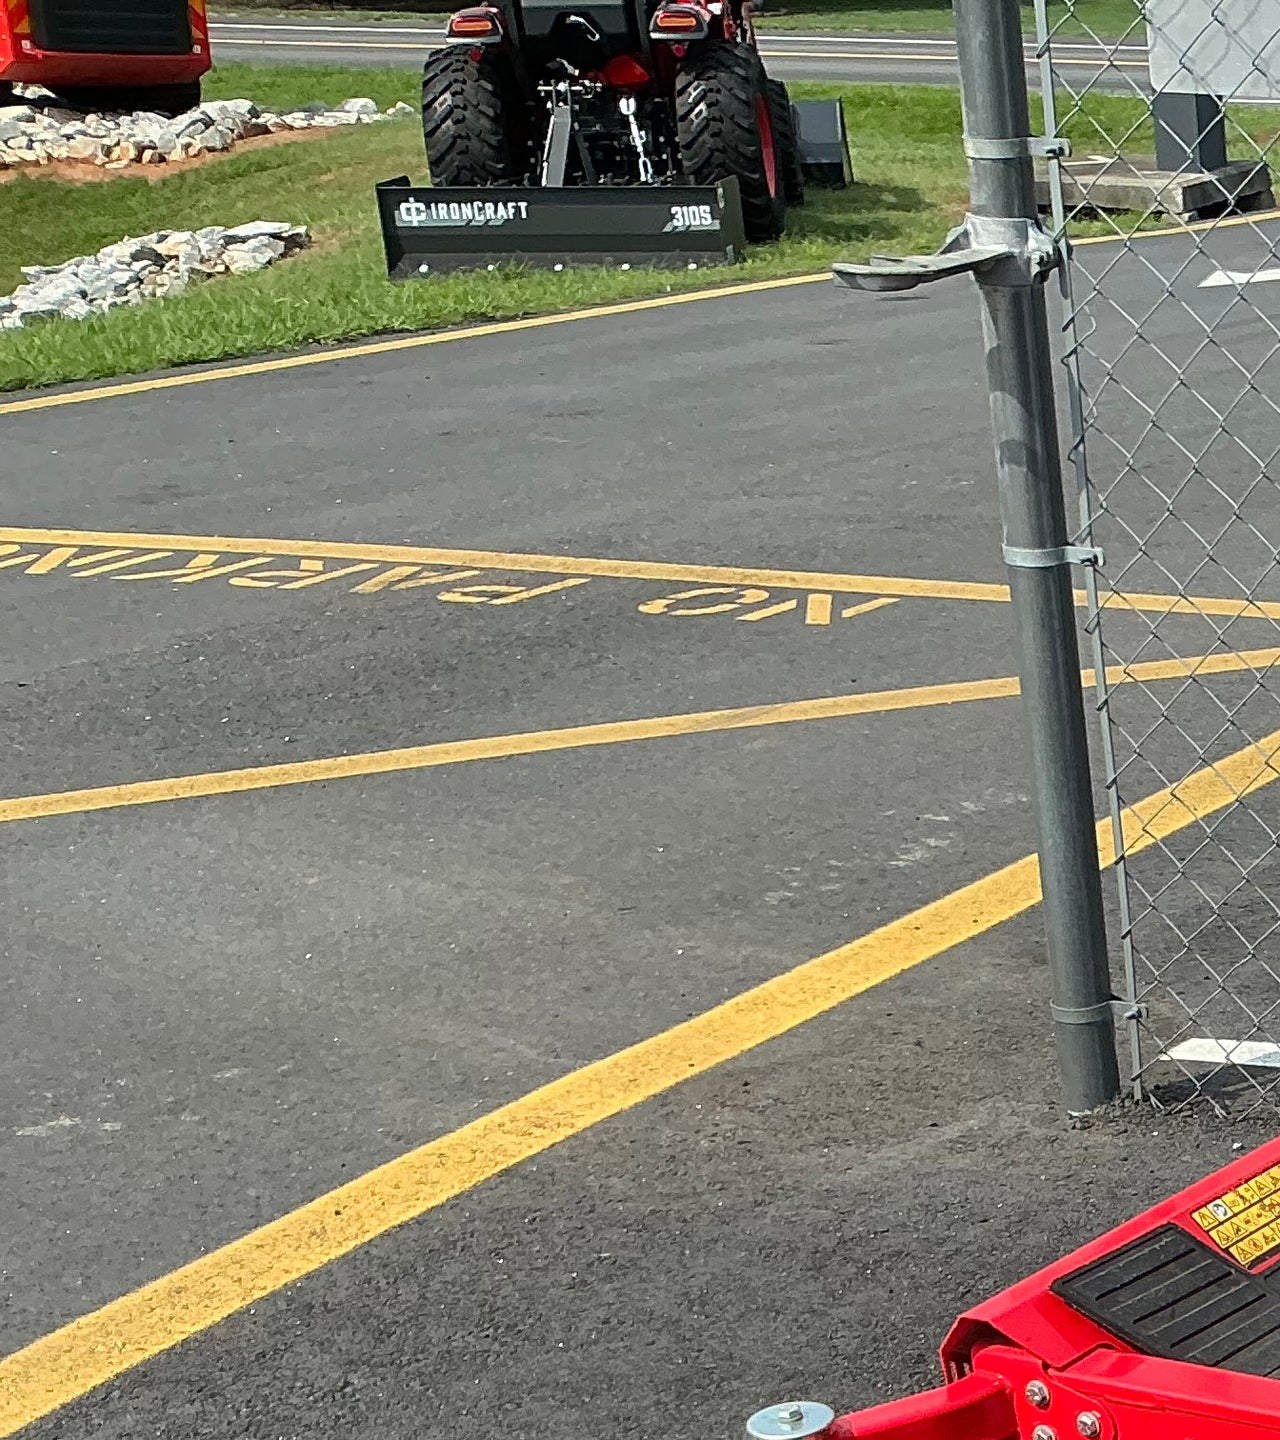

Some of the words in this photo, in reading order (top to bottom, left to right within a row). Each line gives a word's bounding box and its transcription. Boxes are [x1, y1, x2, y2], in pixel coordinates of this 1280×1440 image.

[430, 201, 528, 221] IRONCRAFT
[0, 543, 591, 606] PARKIN
[634, 586, 902, 627] NO
